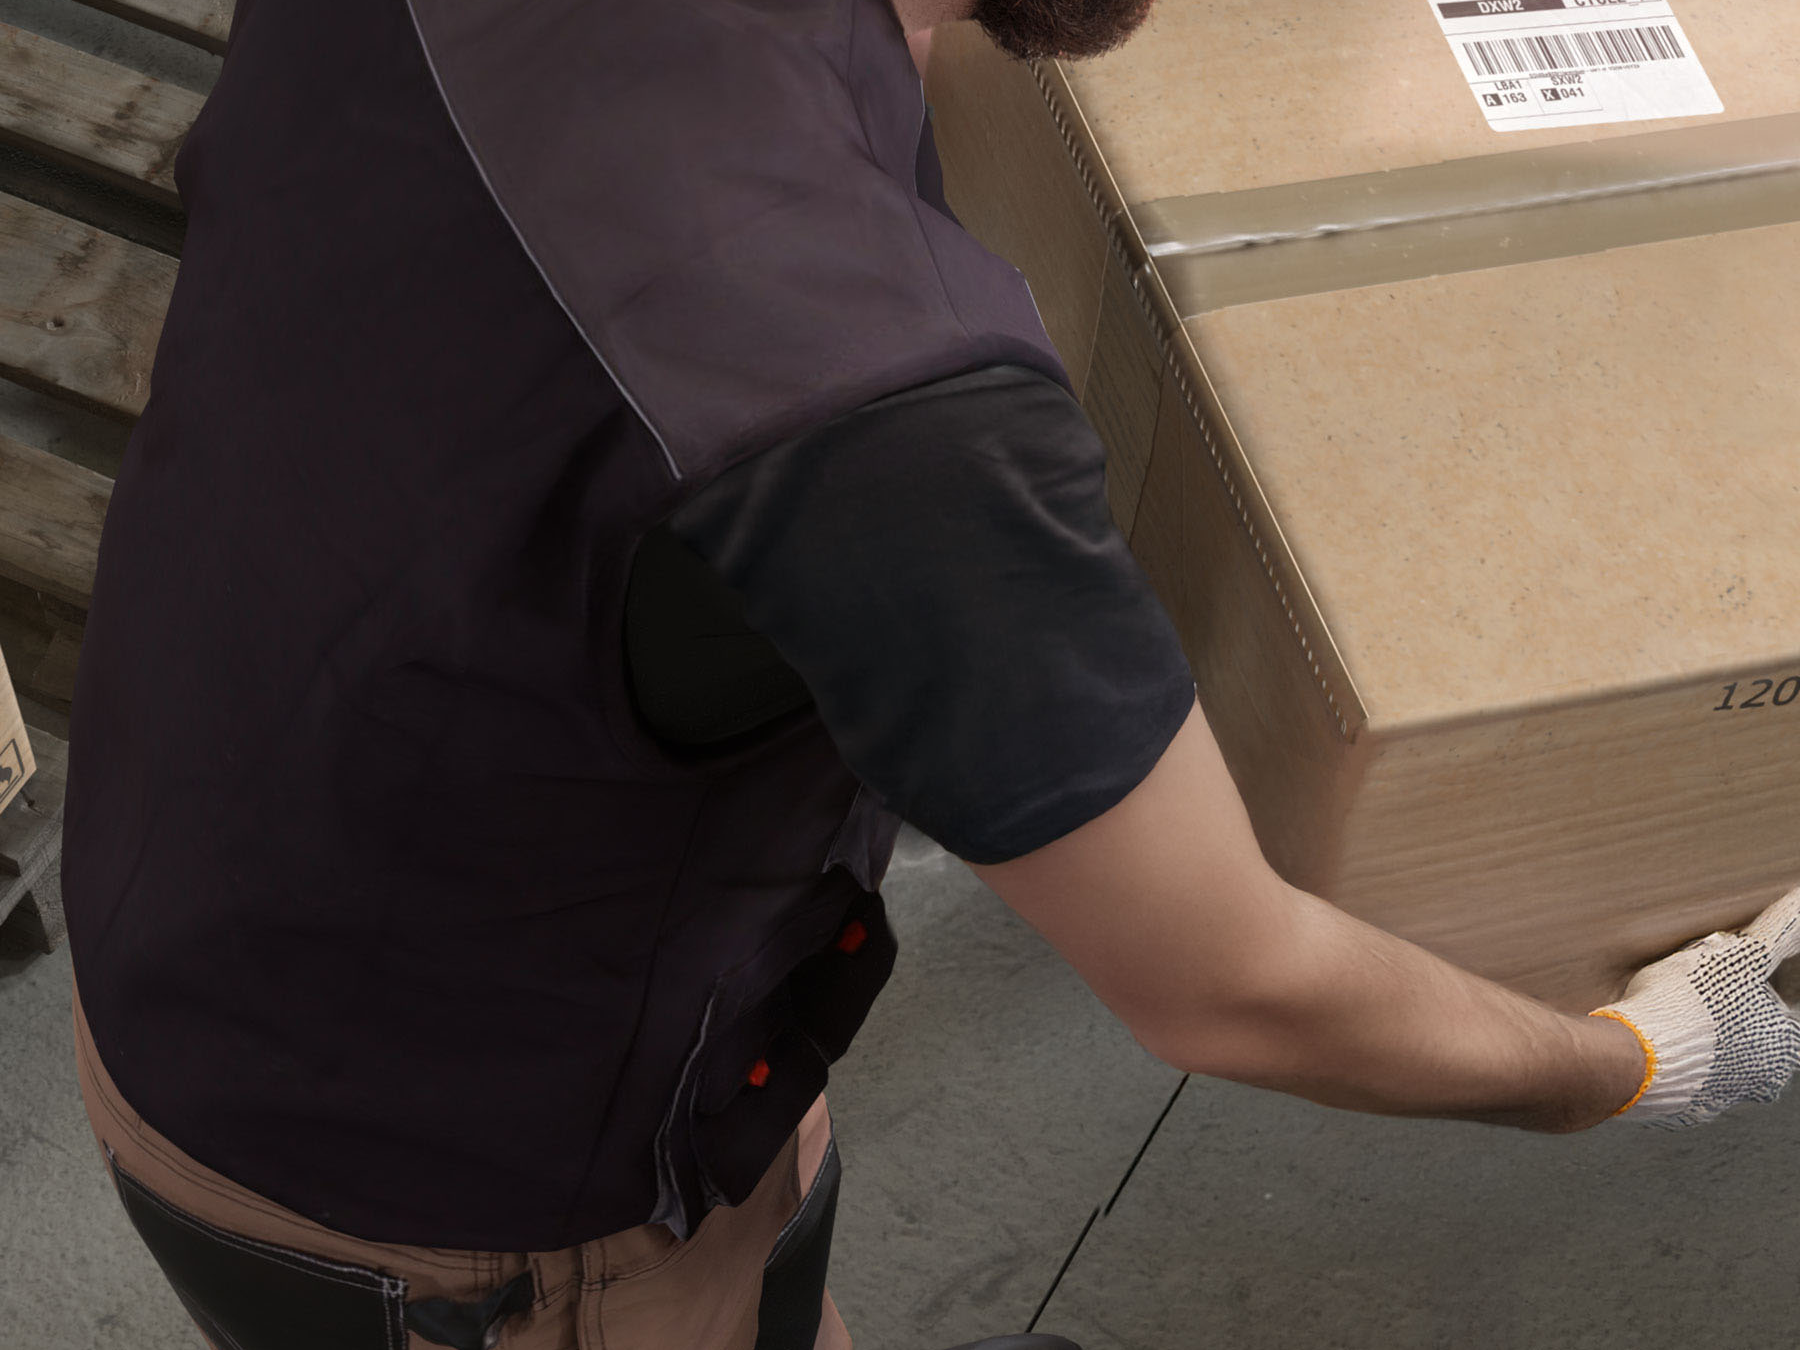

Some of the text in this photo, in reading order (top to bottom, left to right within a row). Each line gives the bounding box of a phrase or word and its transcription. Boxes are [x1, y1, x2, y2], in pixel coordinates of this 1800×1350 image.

[1477, 0, 1525, 14] DXW2
[1494, 80, 1523, 92] LBA1
[1550, 74, 1584, 86] SXW2
[1502, 92, 1528, 104] 163
[1560, 87, 1585, 99] 041
